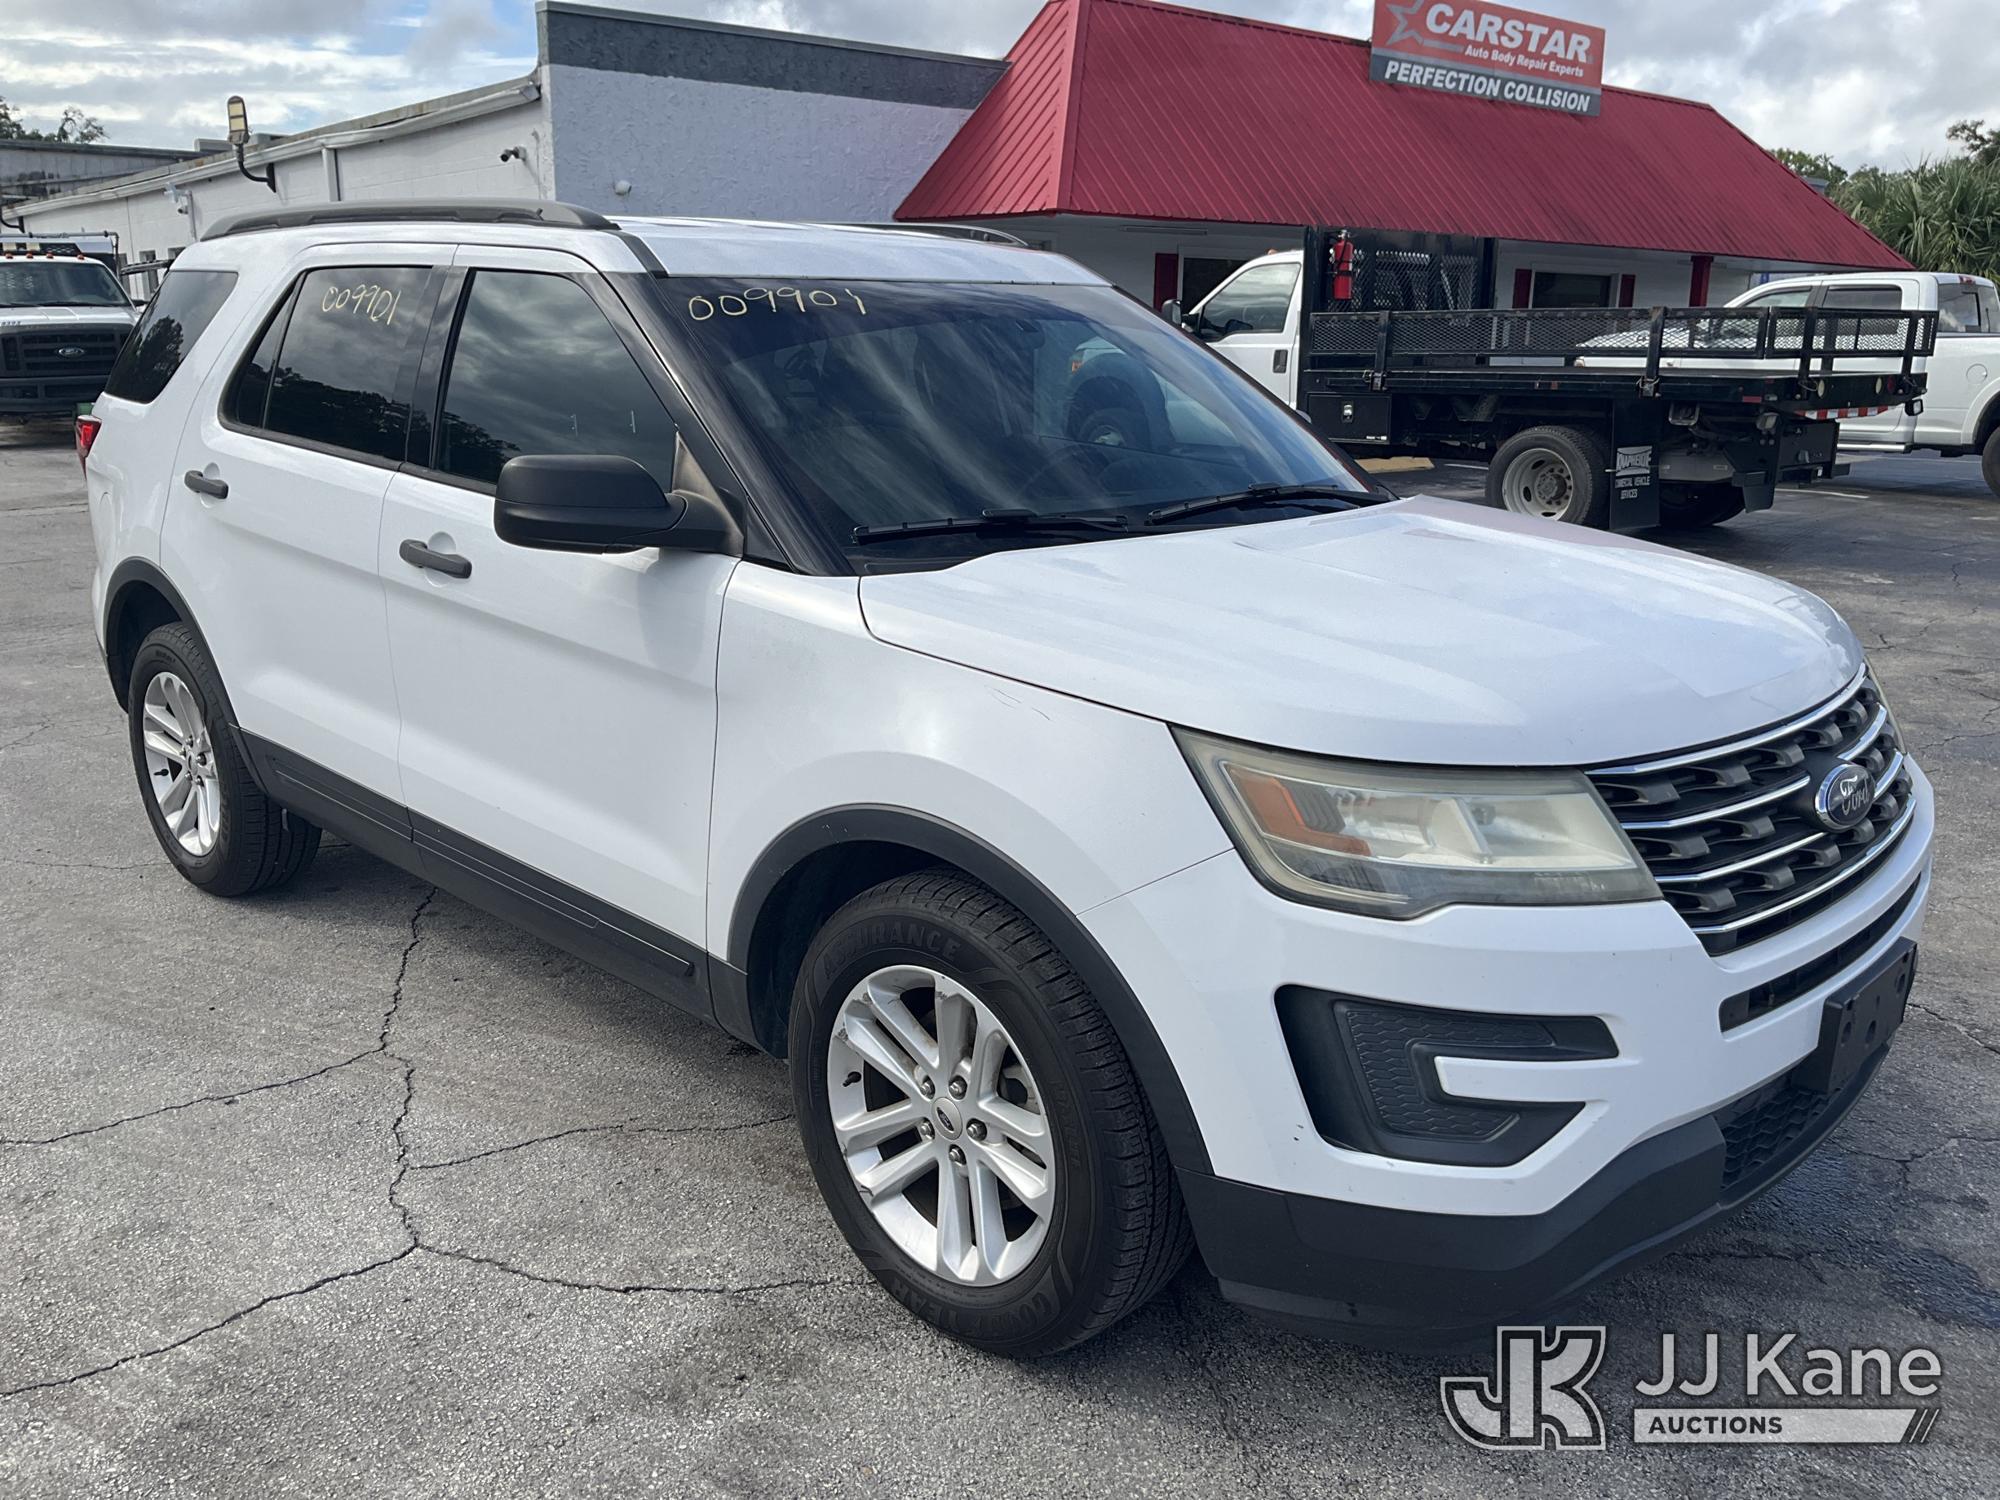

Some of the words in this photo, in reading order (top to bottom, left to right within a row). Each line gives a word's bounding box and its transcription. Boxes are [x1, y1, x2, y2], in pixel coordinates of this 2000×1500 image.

[1426, 3, 1591, 64] CARSTAR
[1465, 44, 1489, 60] Auto
[1491, 49, 1516, 67] Body
[1517, 55, 1548, 72] Repair
[1549, 61, 1584, 78] Experts
[1384, 60, 1501, 97] PERFECTION
[1504, 82, 1591, 113] COLLISION
[322, 284, 401, 325] 009901
[688, 287, 866, 321] 009901
[1840, 775, 1870, 816] Ford
